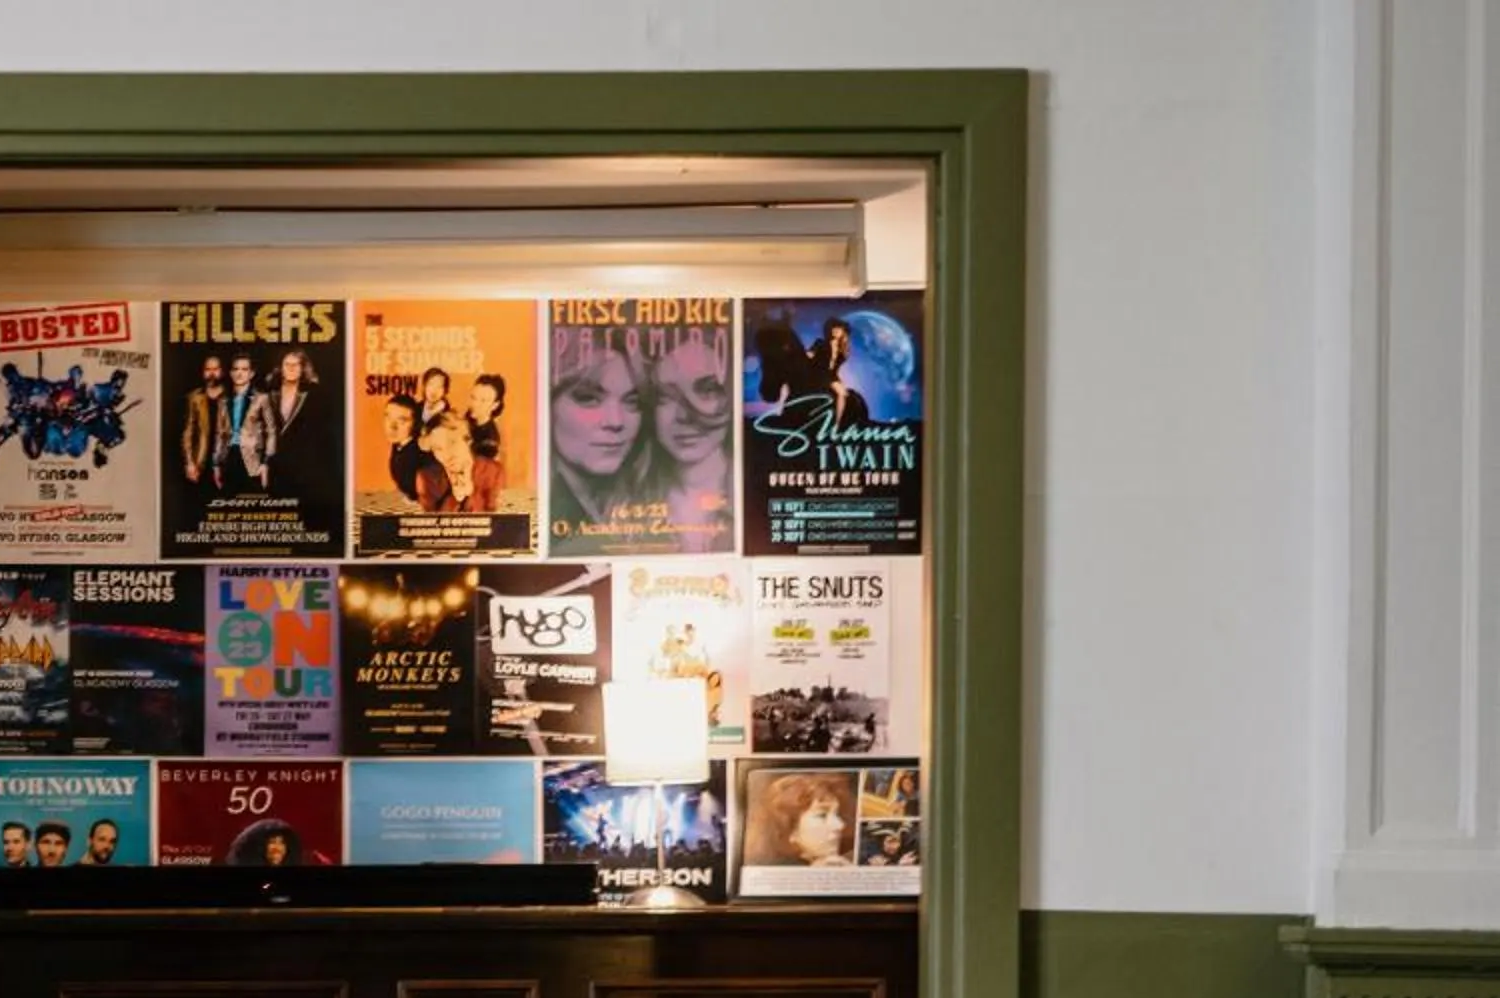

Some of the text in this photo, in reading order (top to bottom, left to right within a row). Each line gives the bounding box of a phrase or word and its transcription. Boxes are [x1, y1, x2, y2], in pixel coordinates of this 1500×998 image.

[636, 299, 681, 325] AID
[0, 311, 120, 344] BUSTED
[168, 303, 339, 344] KILLERS
[384, 326, 477, 351] SECONDS
[366, 350, 484, 375] OF SUMMER
[366, 375, 419, 396] SHOW
[816, 445, 917, 471] TWAIN
[28, 463, 90, 482] hanson
[768, 472, 816, 488] QUEEN
[72, 570, 178, 588] ELEPHANT
[219, 567, 330, 579] HARRY STYLES
[72, 586, 176, 604] SESSIONS
[219, 579, 332, 613] LOVE
[757, 576, 801, 599] THE
[808, 576, 885, 599] SNUTS
[369, 651, 454, 667] ARCTIC
[495, 660, 540, 678] LOYLE
[213, 667, 335, 699] TOUR
[355, 667, 464, 684] MONKEYS
[160, 769, 340, 784] BEVERLEY KNIGHT
[226, 786, 274, 815] 50
